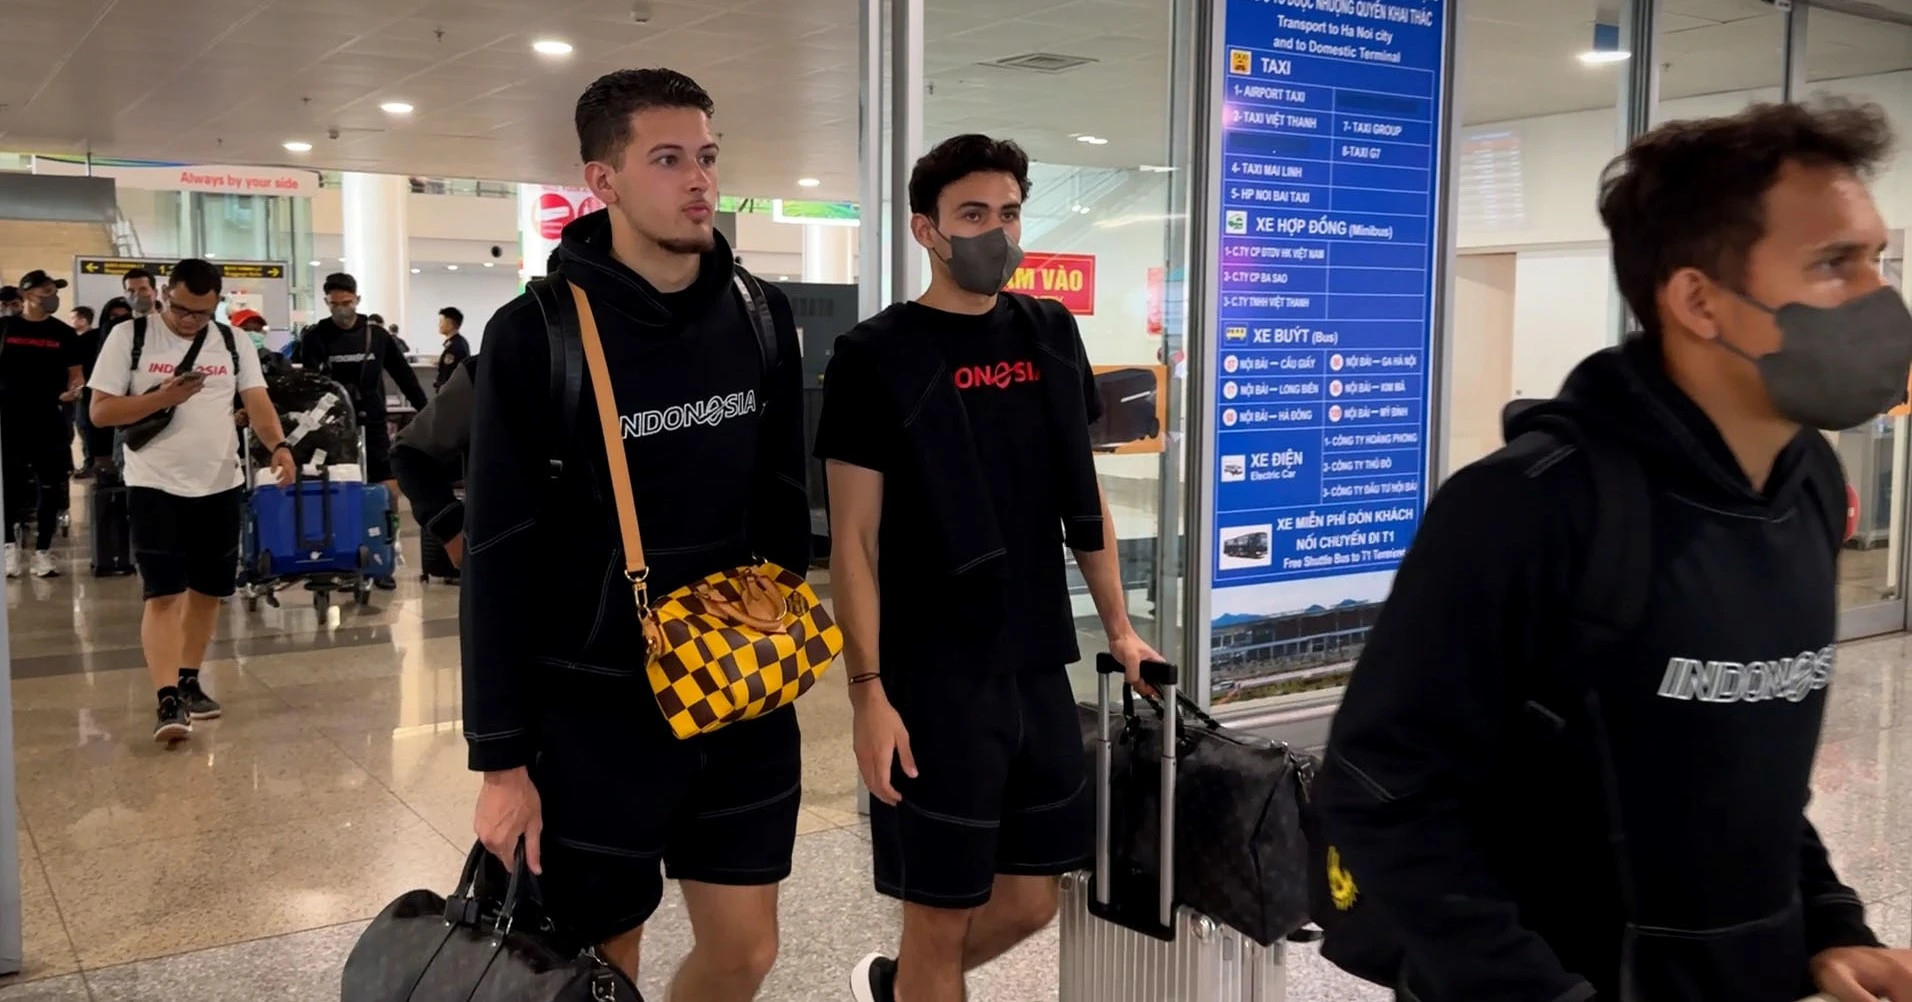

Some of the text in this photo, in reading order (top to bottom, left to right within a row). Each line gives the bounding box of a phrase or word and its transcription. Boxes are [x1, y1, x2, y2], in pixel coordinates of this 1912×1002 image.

[1388, 6, 1408, 22] KHAI
[1410, 7, 1432, 27] THÁC
[1277, 14, 1393, 45] Transport to Ha Noi city
[1273, 37, 1401, 63] and to Domestic Terminal
[1261, 57, 1291, 75] TAXI
[1244, 85, 1283, 100] AIRPORT
[1285, 89, 1305, 103] TAXI
[1243, 111, 1264, 124] TAXI
[1265, 112, 1285, 129] VIỆT
[1287, 115, 1317, 129] THANH
[1352, 121, 1372, 134] TAXI
[1373, 124, 1402, 136] GROUP
[1369, 148, 1381, 159] G7
[1241, 162, 1263, 175] TAXI
[1264, 164, 1280, 176] MAI
[1281, 165, 1302, 178] LINH
[181, 171, 299, 189] Always by your side
[1241, 188, 1254, 200] HP
[1290, 191, 1310, 203] TAXI
[1256, 216, 1274, 232] XE
[1277, 217, 1306, 237] HỢP
[1349, 224, 1393, 240] (Minibus)
[1042, 264, 1083, 291] VÀO
[1253, 325, 1338, 345] XE BUÝT (Bus)
[619, 389, 756, 440] NDONESIA
[1250, 448, 1303, 470] XE ĐIỆN
[1250, 469, 1297, 481] Electric Car
[1276, 517, 1294, 531] XE
[1326, 510, 1346, 527] PHÍ
[1375, 506, 1414, 522] KHÁCH
[1296, 532, 1317, 551] NỐI
[1382, 531, 1394, 543] T1
[1283, 557, 1303, 569] Free
[1303, 554, 1333, 568] Shuttle
[1334, 552, 1350, 564] Bus
[1351, 552, 1361, 562] to
